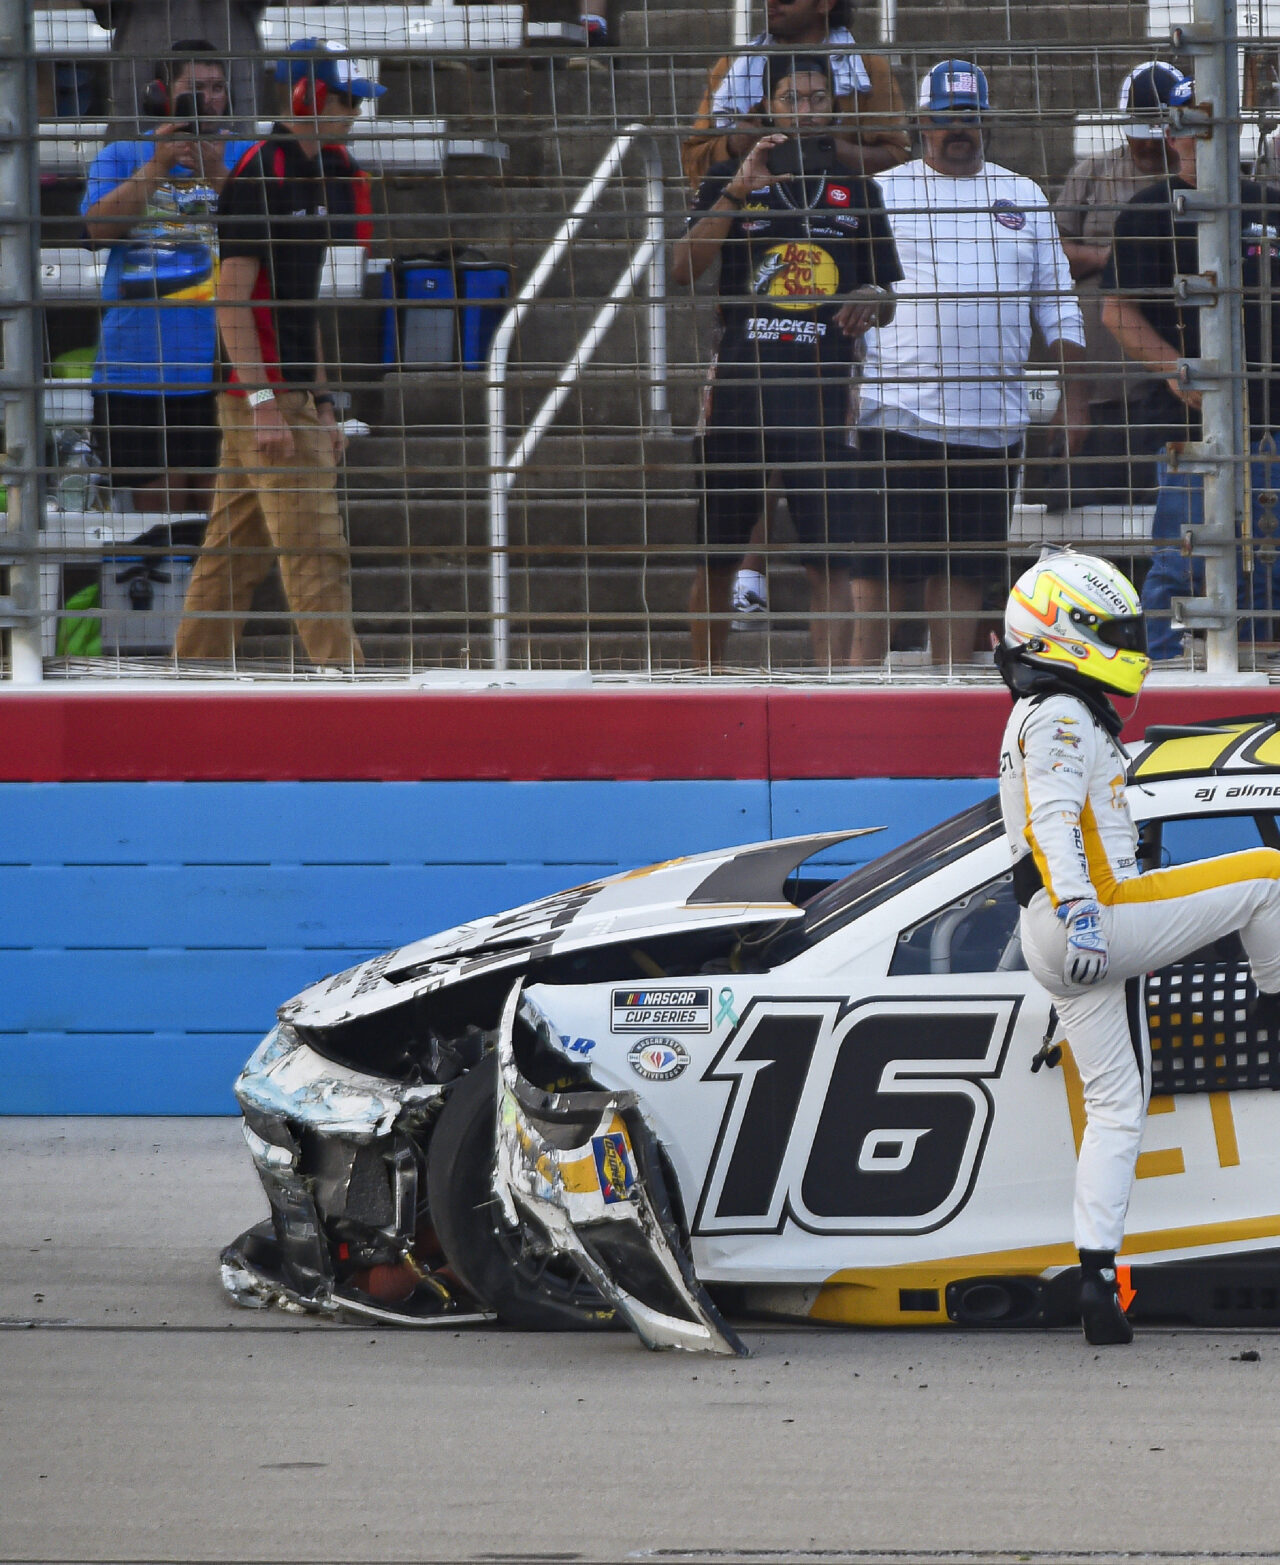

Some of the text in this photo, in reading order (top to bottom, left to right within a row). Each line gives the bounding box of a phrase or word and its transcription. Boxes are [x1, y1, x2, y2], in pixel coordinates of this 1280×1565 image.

[1243, 13, 1259, 24] 16
[784, 244, 822, 264] Bass
[46, 265, 55, 277] 2
[787, 264, 812, 281] Pro
[747, 317, 827, 336] TRACKER
[748, 331, 780, 341] BOATS
[1028, 389, 1046, 401] 16
[1083, 571, 1128, 614] Nutrien
[1194, 784, 1217, 801] aj
[643, 991, 697, 1005] NASCAR
[625, 1010, 697, 1022] CUP SERIES
[636, 1038, 662, 1050] NASCAR
[634, 1063, 682, 1080] ANNIVERSARY
[690, 995, 1025, 1236] 16
